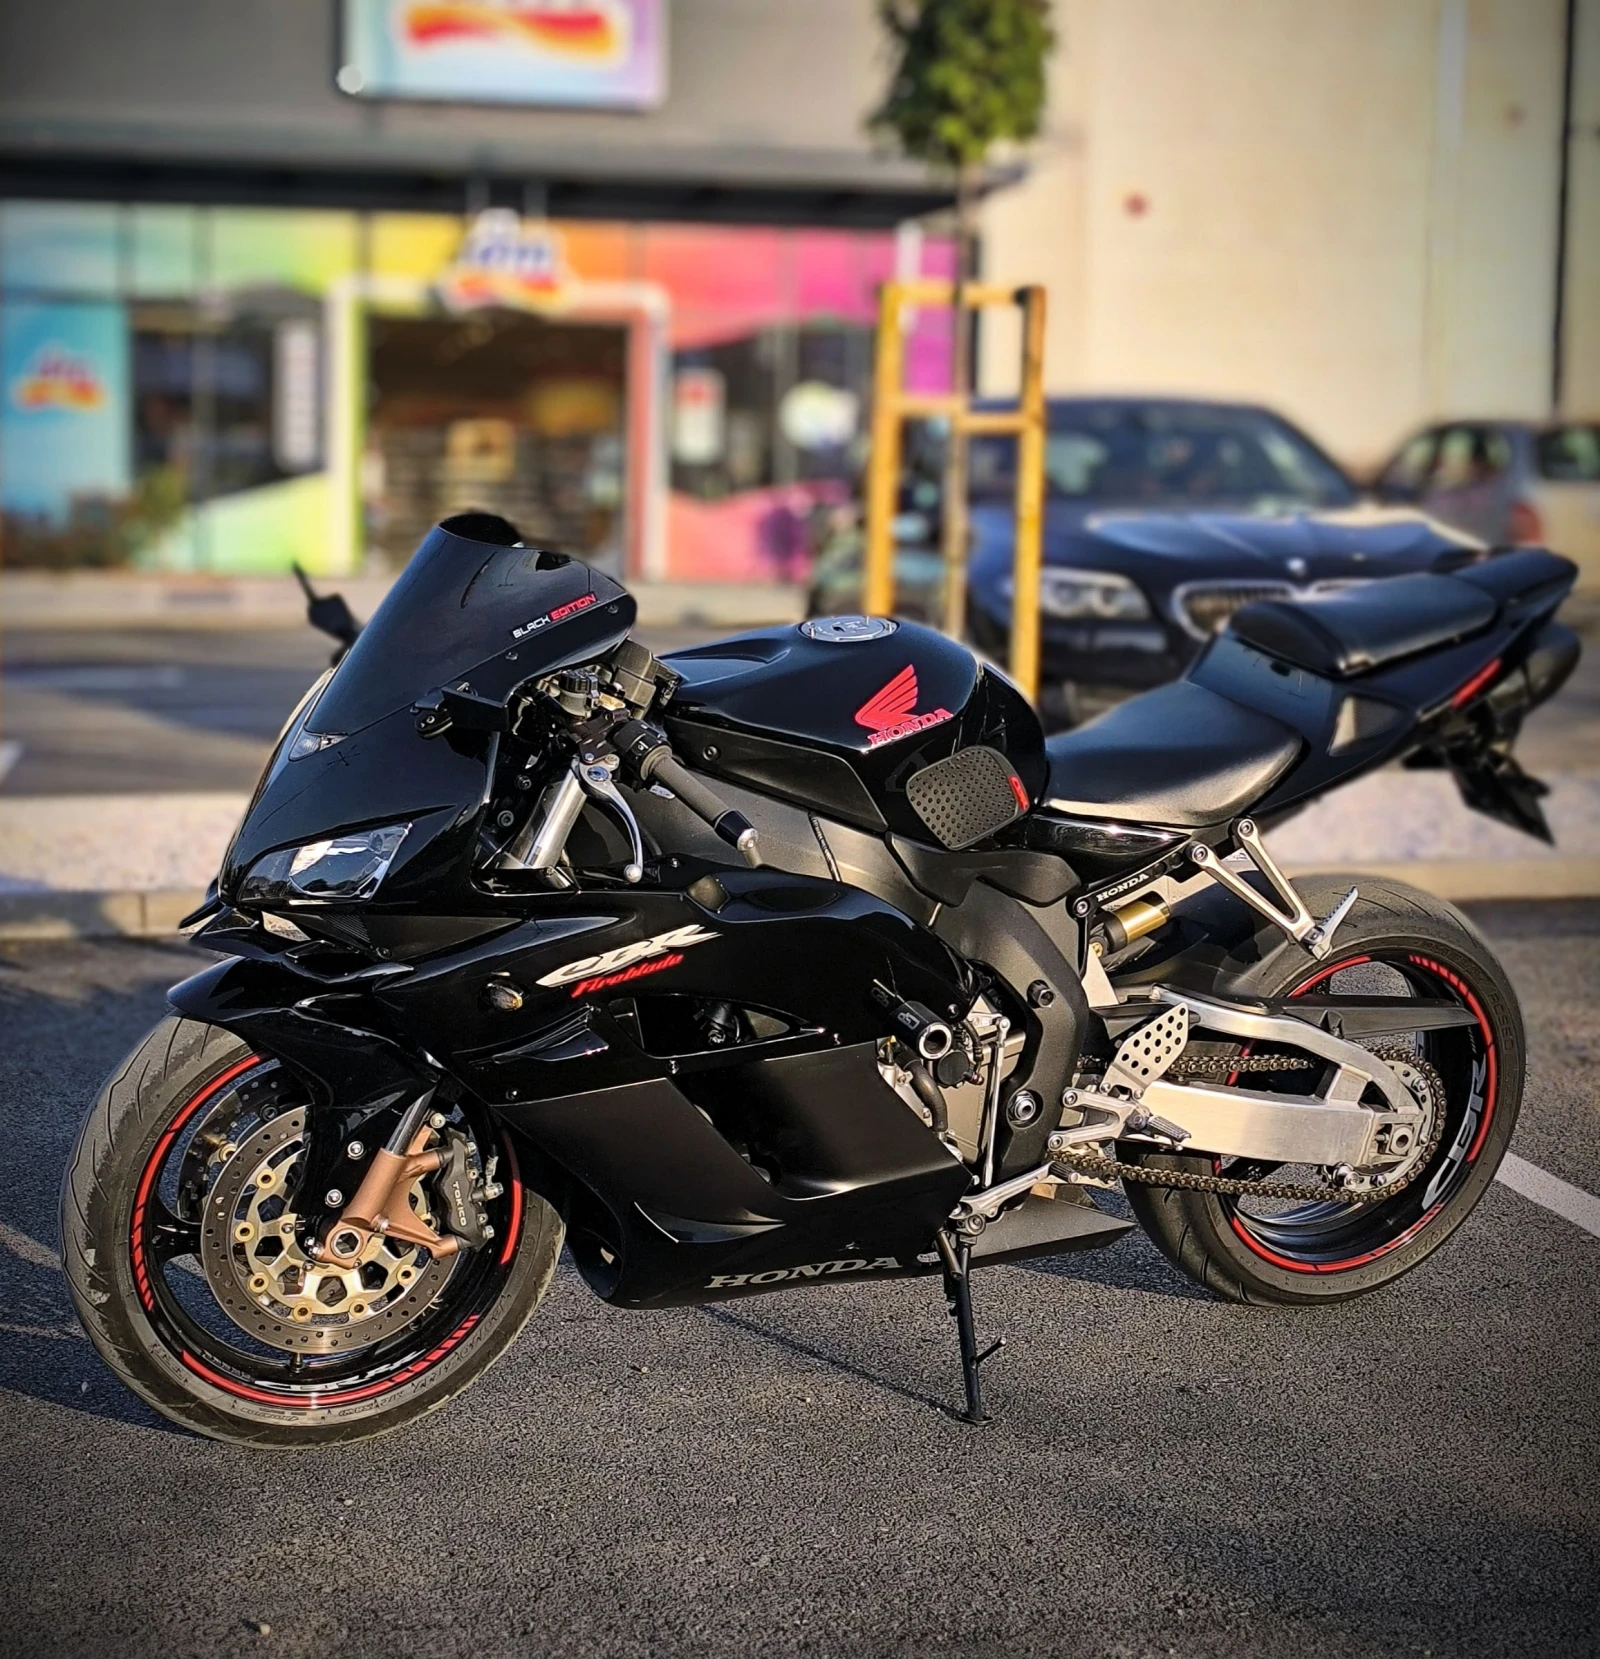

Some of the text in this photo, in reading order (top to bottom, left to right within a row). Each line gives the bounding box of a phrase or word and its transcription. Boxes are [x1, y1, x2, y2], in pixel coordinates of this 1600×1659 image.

[512, 593, 597, 639] BLACK EDITION
[867, 707, 954, 748] HONDA
[1095, 873, 1150, 902] HONDA
[535, 924, 724, 988] CBR
[1421, 1052, 1487, 1211] CBR
[452, 1180, 467, 1227] TOKICO
[703, 1256, 904, 1289] HONDA
